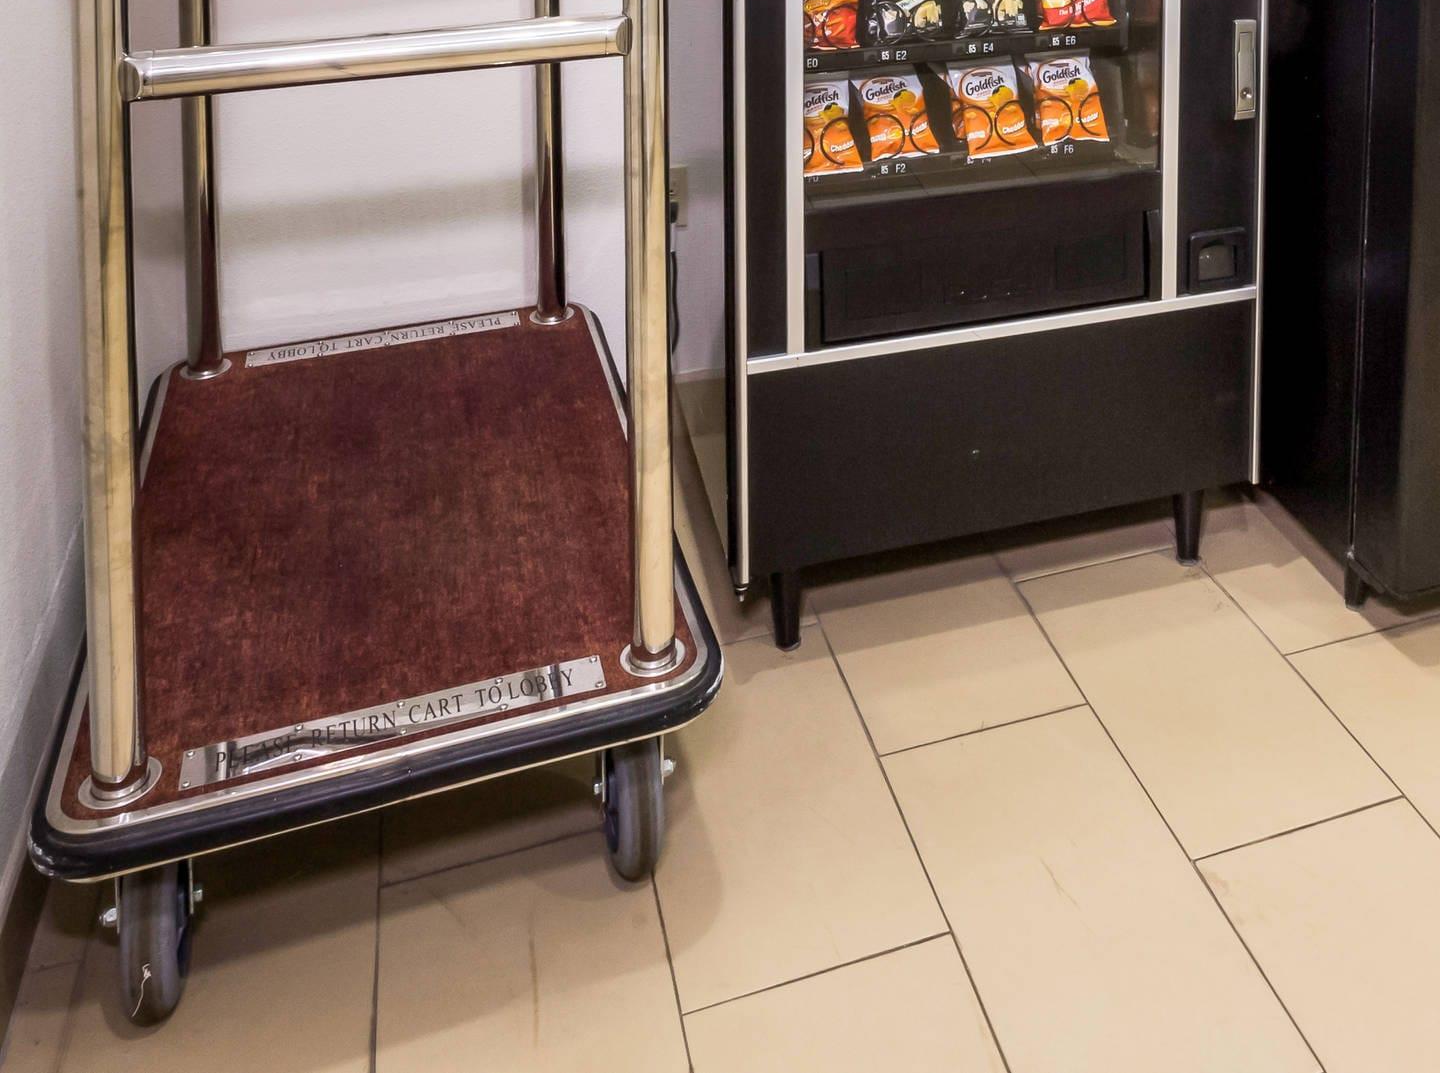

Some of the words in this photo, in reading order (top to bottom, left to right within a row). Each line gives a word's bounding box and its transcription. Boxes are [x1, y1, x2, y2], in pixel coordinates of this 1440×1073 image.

[1066, 35, 1076, 45] E6
[896, 50, 907, 60] E2
[983, 43, 994, 53] E4
[807, 58, 818, 68] E0
[1042, 65, 1081, 84] Goldfish
[865, 80, 907, 101] Goldfish
[965, 76, 1005, 97] Goldfish
[1064, 145, 1073, 154] F6
[896, 163, 906, 173] F2
[453, 317, 501, 332] PLEASE
[391, 326, 444, 341] RETURN
[346, 335, 383, 349] CART
[267, 347, 315, 361] LOBBY
[312, 710, 396, 748] RETURN
[408, 693, 463, 725] CART
[475, 685, 502, 708] TO
